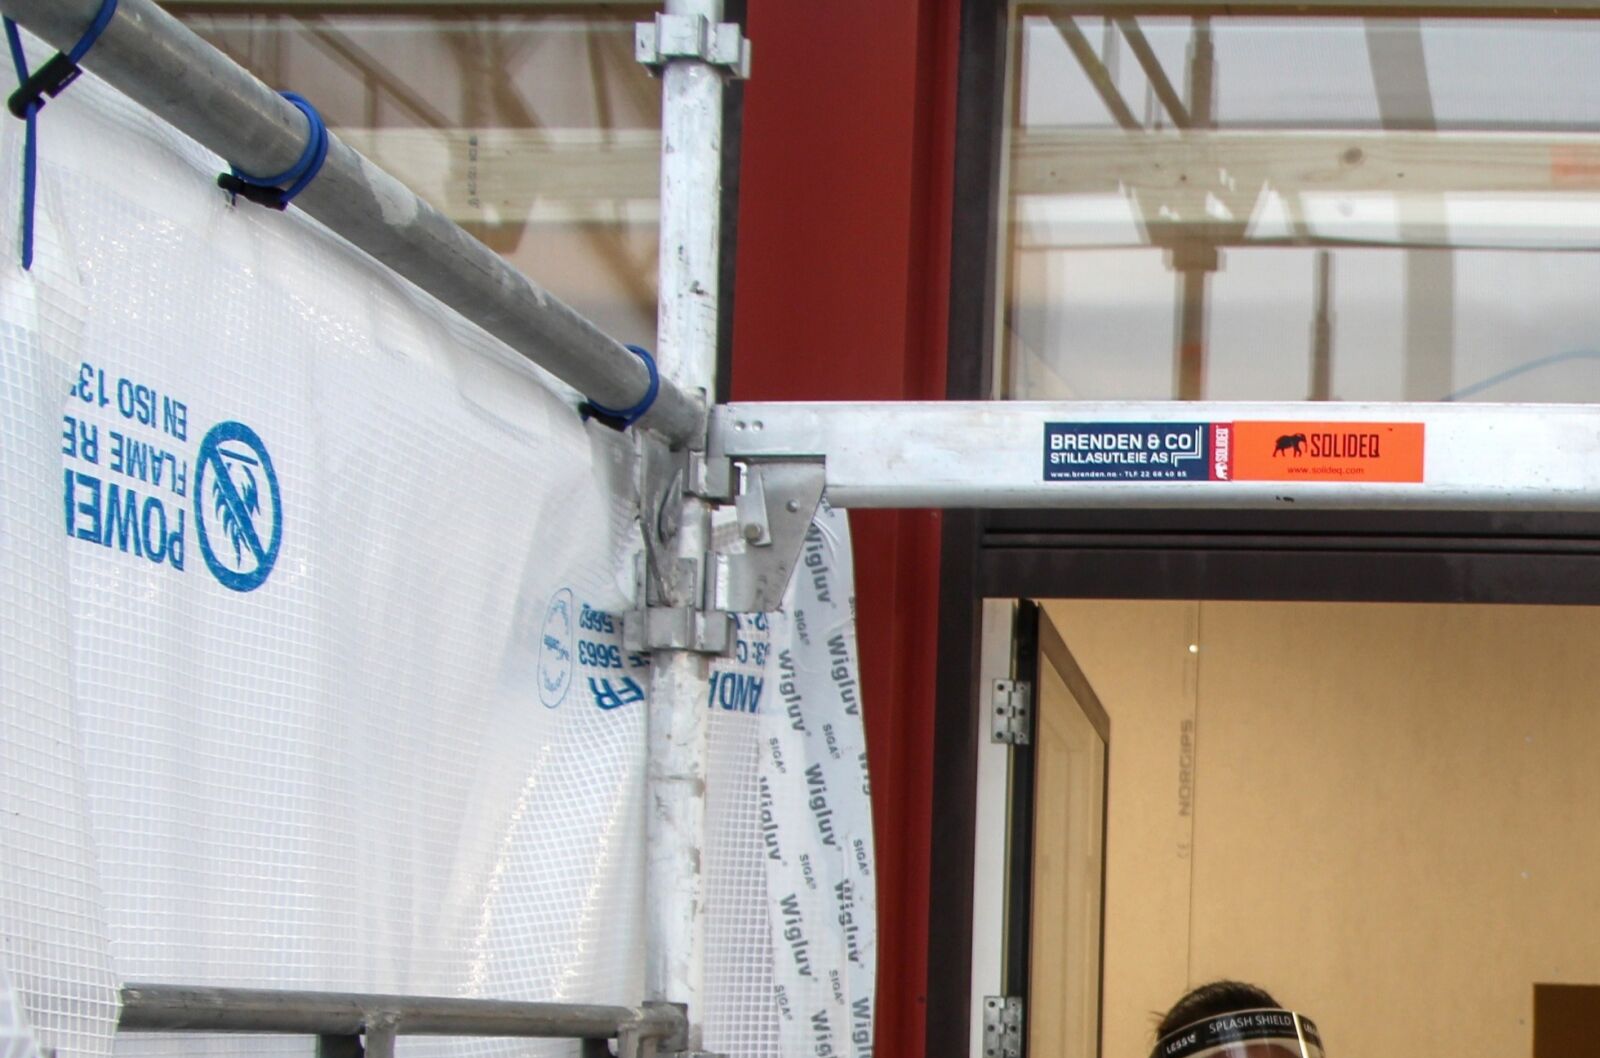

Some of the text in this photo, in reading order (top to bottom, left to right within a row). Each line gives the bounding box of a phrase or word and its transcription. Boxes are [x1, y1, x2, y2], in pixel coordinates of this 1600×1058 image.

[69, 362, 187, 442] EN ISO 13
[109, 431, 187, 498] FLAME
[1050, 433, 1192, 450] BRENDEN & CO
[1050, 452, 1168, 464] STILLASUTLEIE AS
[1287, 465, 1365, 476] www.solideq.com
[1310, 433, 1380, 458] SOLIDEQ
[578, 639, 623, 669] 5663
[827, 634, 859, 716] Wigluv
[778, 650, 806, 732] Wigluv
[1178, 719, 1193, 817] NORGIPS
[804, 763, 836, 847] Wigluv
[779, 893, 812, 977] Wigluv
[1208, 1015, 1292, 1034] SPLASH SHIELD
